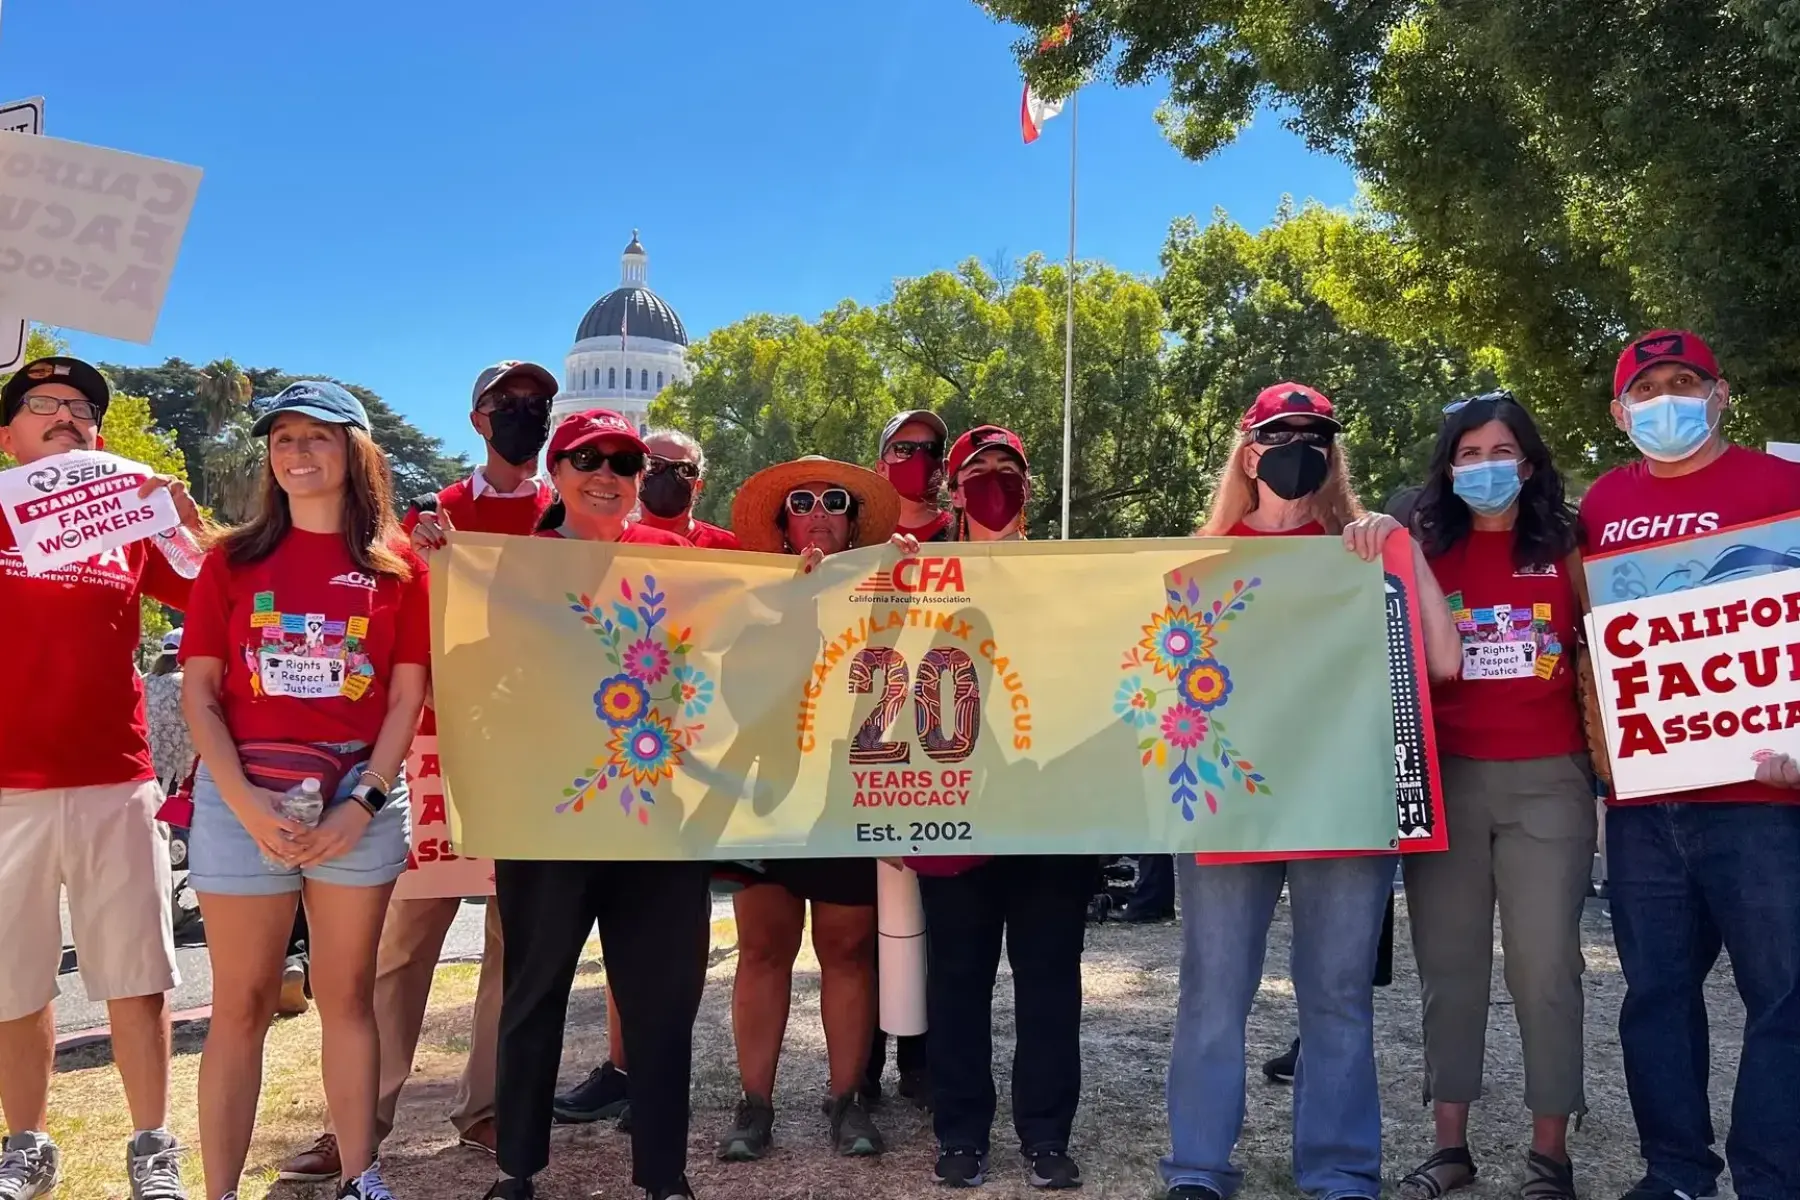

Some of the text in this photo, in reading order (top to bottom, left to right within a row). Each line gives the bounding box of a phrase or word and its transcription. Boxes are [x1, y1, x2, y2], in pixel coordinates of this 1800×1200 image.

[66, 464, 117, 485] SEIU
[27, 476, 137, 517] STAND WITH
[58, 497, 121, 528] FARM
[38, 505, 154, 554] WORKERS
[1600, 512, 1719, 546] RIGHTS
[82, 576, 126, 590] CHAPTER
[893, 558, 965, 592] CFA
[848, 595, 888, 603] California
[891, 596, 920, 604] Faculty
[1483, 645, 1515, 656] Rights
[286, 660, 320, 672] Rights
[1480, 656, 1519, 666] Respect
[281, 671, 324, 682] Respect
[1482, 667, 1518, 676] Justice
[284, 683, 322, 693] Justice
[796, 609, 1032, 754] CHICANX/LATINX CAUCUS
[848, 647, 981, 765] 20
[852, 770, 973, 789] YEARS OF
[853, 790, 970, 807] ADVOCACY
[857, 822, 972, 841] Est. 2002
